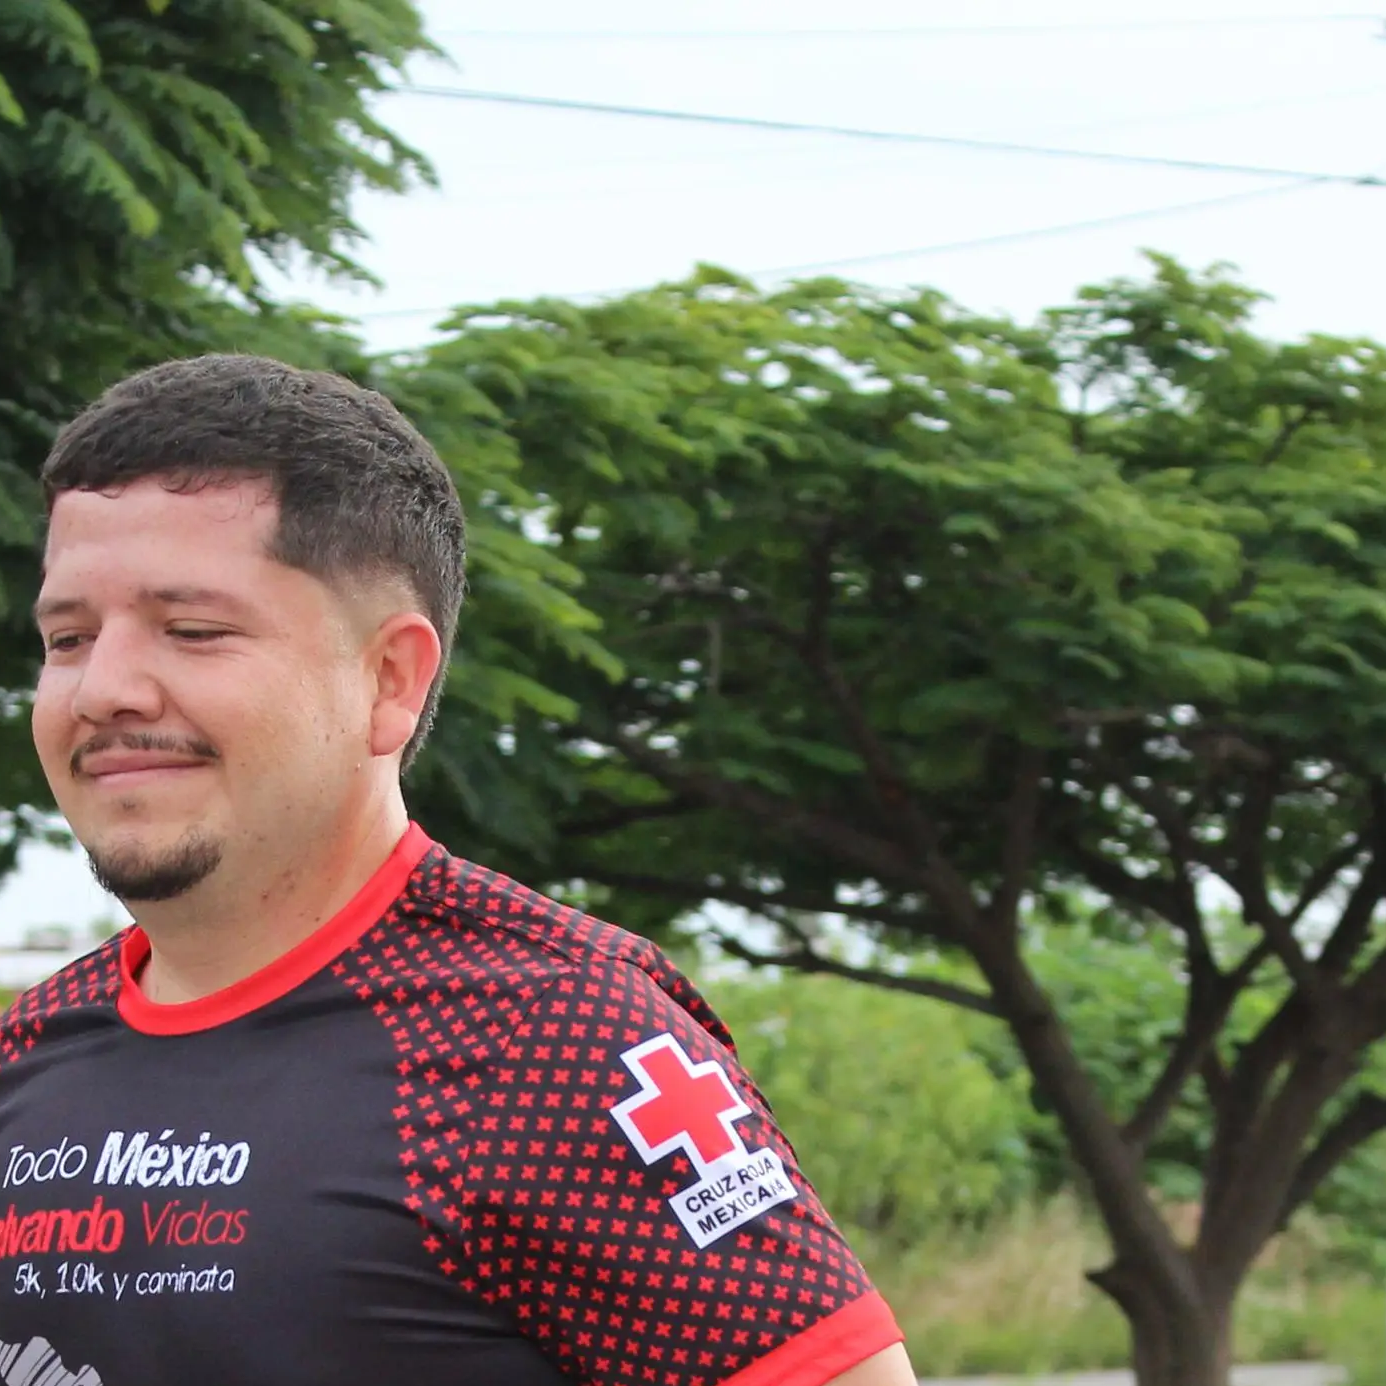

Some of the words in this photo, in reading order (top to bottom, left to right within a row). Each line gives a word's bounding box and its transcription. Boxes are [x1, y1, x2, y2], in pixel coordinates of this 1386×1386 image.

[3, 1137, 87, 1188] Todo
[93, 1128, 251, 1188] México
[685, 1174, 737, 1214] CRUZ
[737, 1157, 775, 1185] ROJA
[141, 1200, 250, 1246] Vidas
[697, 1178, 787, 1235] MEXICANA
[14, 1263, 46, 1299] 5k,
[56, 1262, 104, 1295] 10k
[113, 1272, 128, 1301] y
[136, 1263, 235, 1296] caminata
